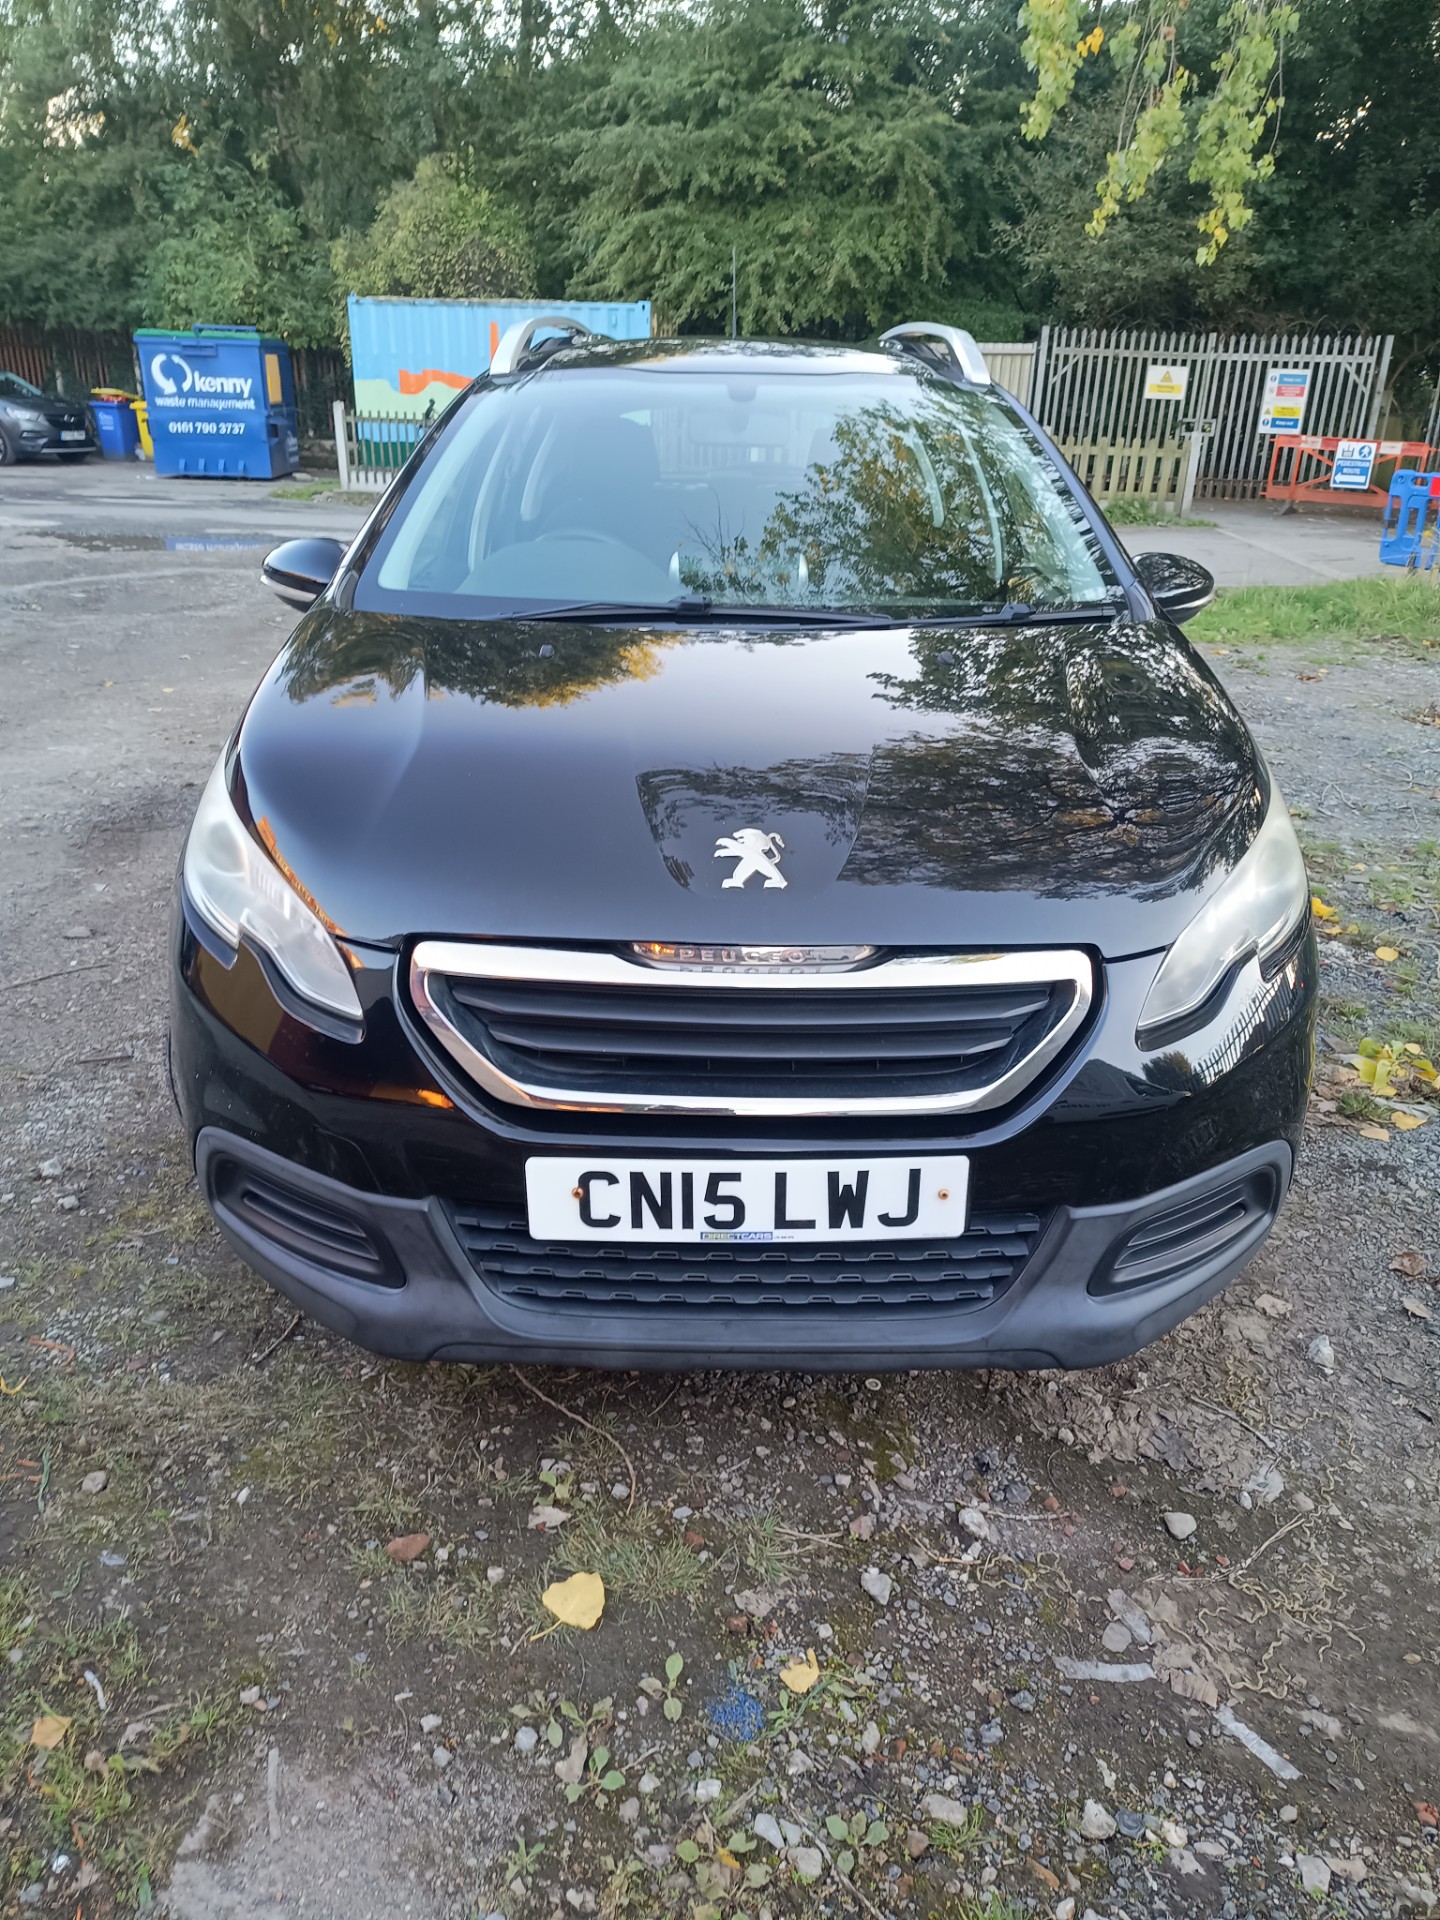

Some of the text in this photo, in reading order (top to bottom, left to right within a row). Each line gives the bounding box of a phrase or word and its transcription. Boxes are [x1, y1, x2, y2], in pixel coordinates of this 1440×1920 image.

[193, 370, 252, 398] kenny
[154, 395, 256, 411] waste management
[168, 421, 246, 435] 0161 790 3737
[679, 948, 827, 963] PEUGEOT
[577, 1168, 922, 1230] CN15 LWJ
